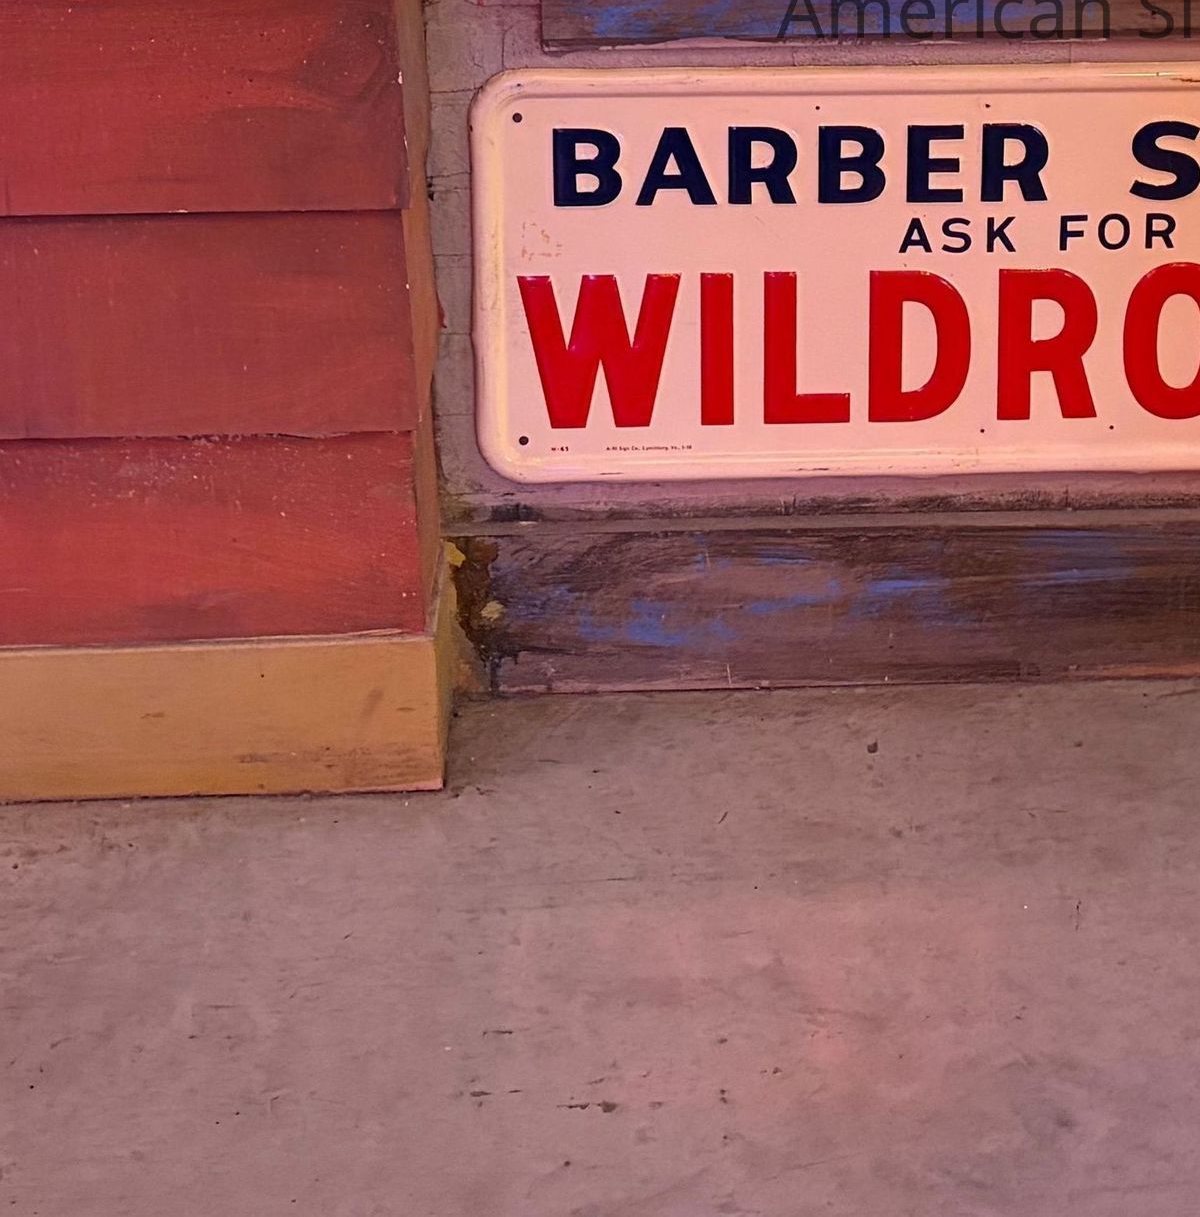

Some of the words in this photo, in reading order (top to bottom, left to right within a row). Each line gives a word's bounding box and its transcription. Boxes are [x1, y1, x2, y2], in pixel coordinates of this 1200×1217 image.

[552, 123, 1050, 207] BARBER
[898, 216, 1017, 255] ASK
[1058, 213, 1178, 253] FOR
